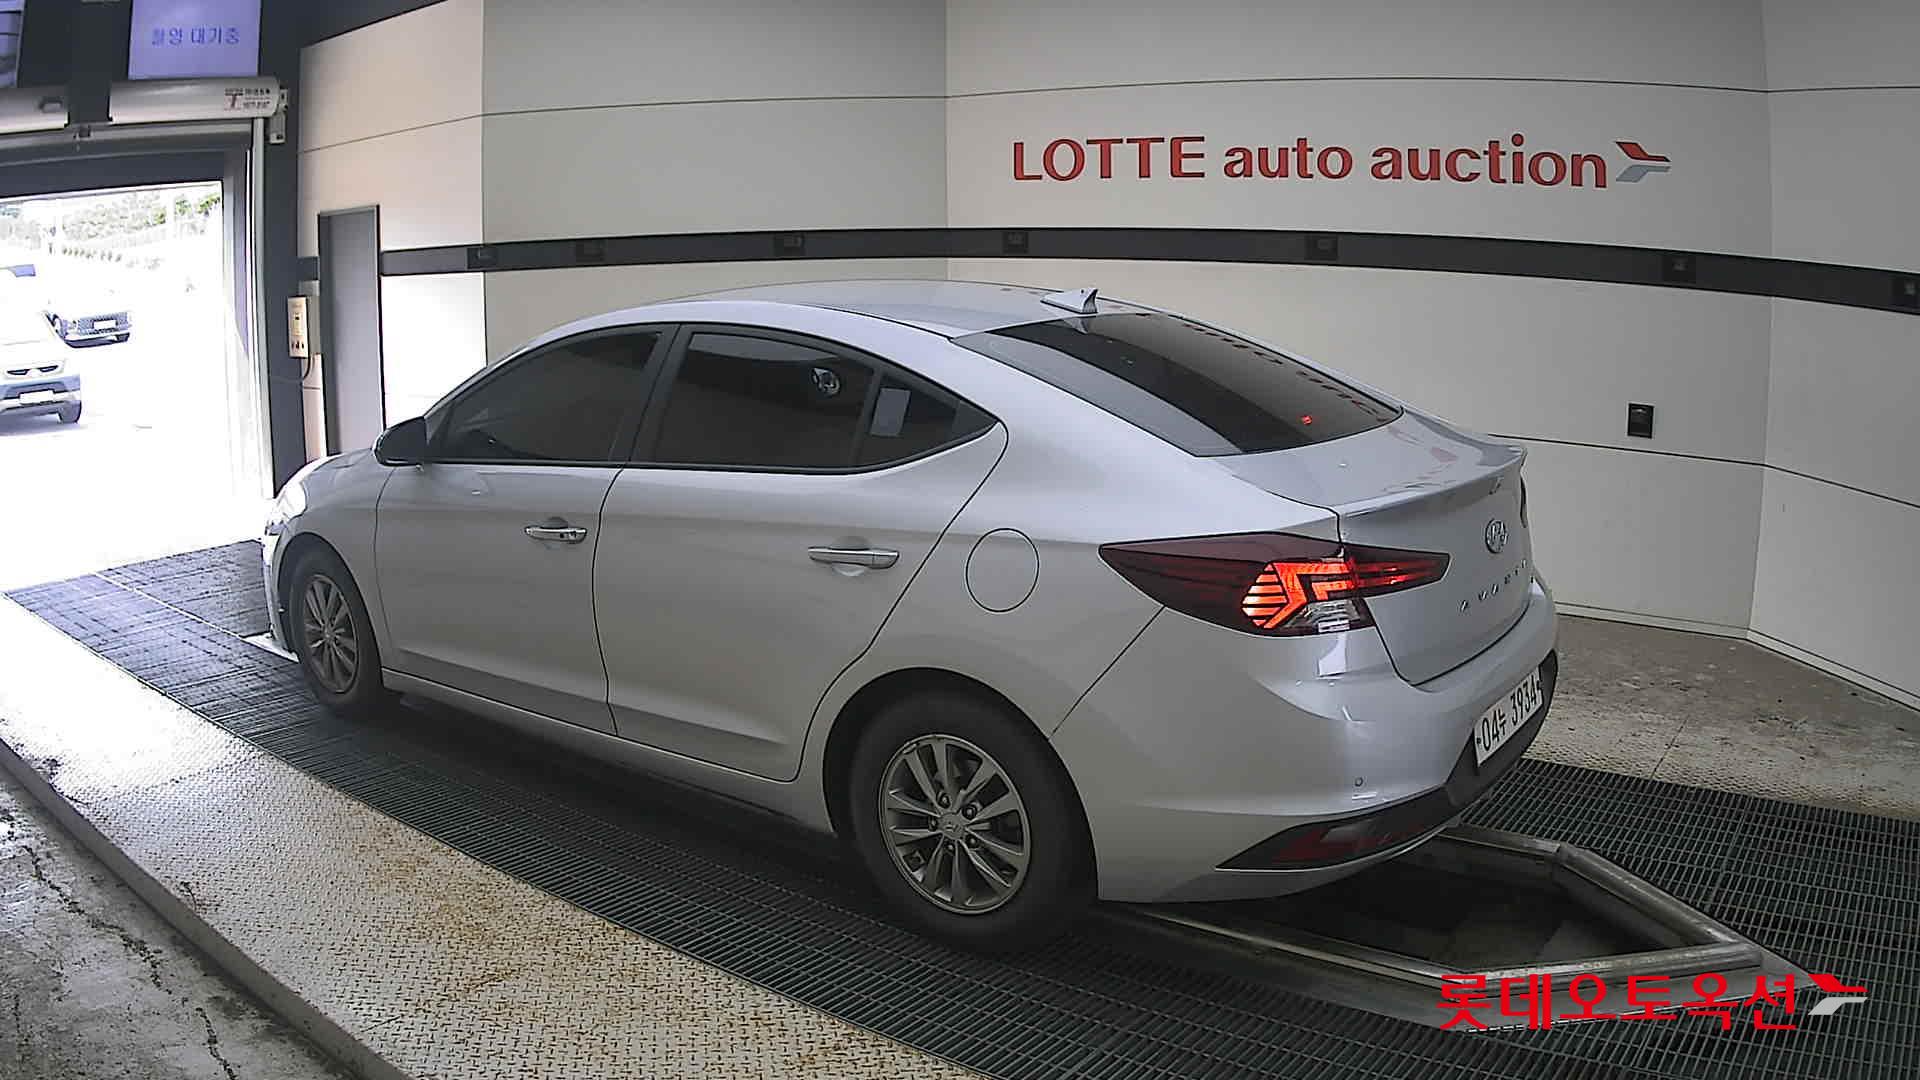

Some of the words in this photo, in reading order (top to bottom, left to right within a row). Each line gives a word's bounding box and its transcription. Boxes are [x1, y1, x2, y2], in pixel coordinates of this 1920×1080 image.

[191, 27, 240, 45] 대기중
[1013, 136, 1205, 181] LOTTE
[1223, 138, 1353, 179] auto
[1370, 133, 1607, 188] auction
[1481, 708, 1507, 751] 04누
[1510, 674, 1538, 726] 3934
